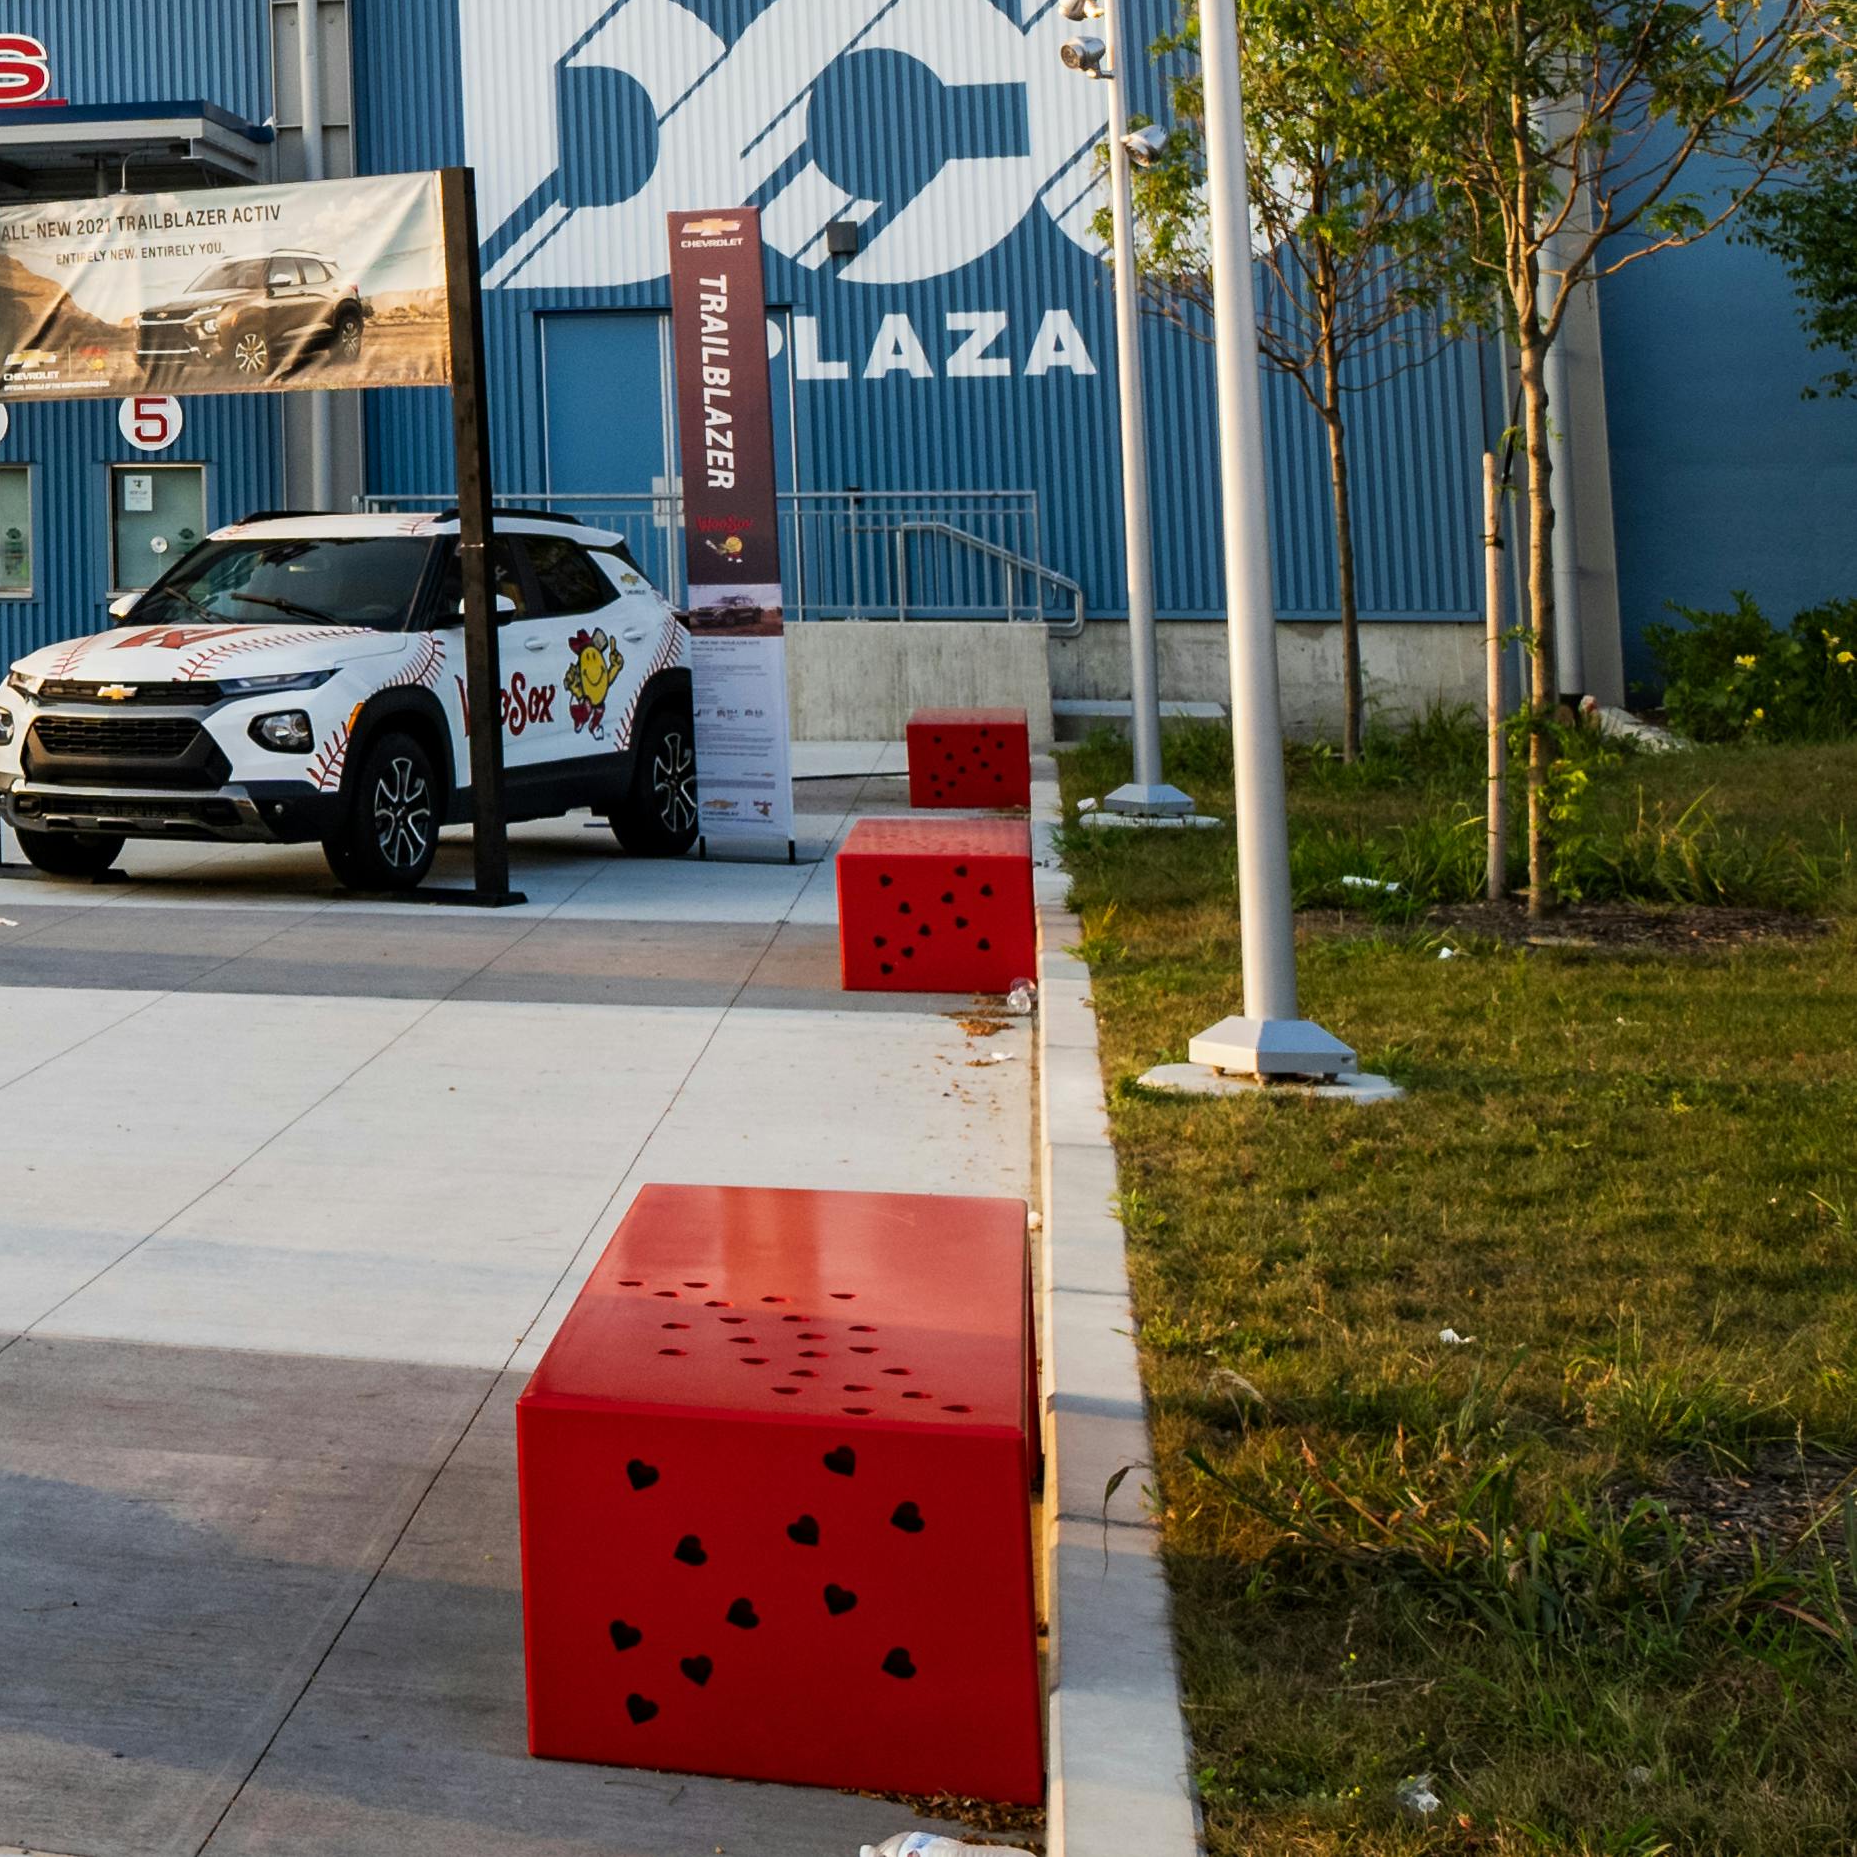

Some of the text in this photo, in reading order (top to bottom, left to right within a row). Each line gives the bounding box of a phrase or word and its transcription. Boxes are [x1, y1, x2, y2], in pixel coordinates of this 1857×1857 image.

[1, 203, 282, 242] ALL-NEW 2021 TRAILBLAZER ACTIV
[55, 241, 226, 266] ENTIRELY NEW. ENTIRELY YOU.
[680, 237, 744, 249] CHEVROLET
[3, 371, 60, 382] CHEVROLET
[698, 273, 736, 490] TRAILBLAZER
[133, 397, 170, 444] 5
[454, 671, 556, 739] oSox
